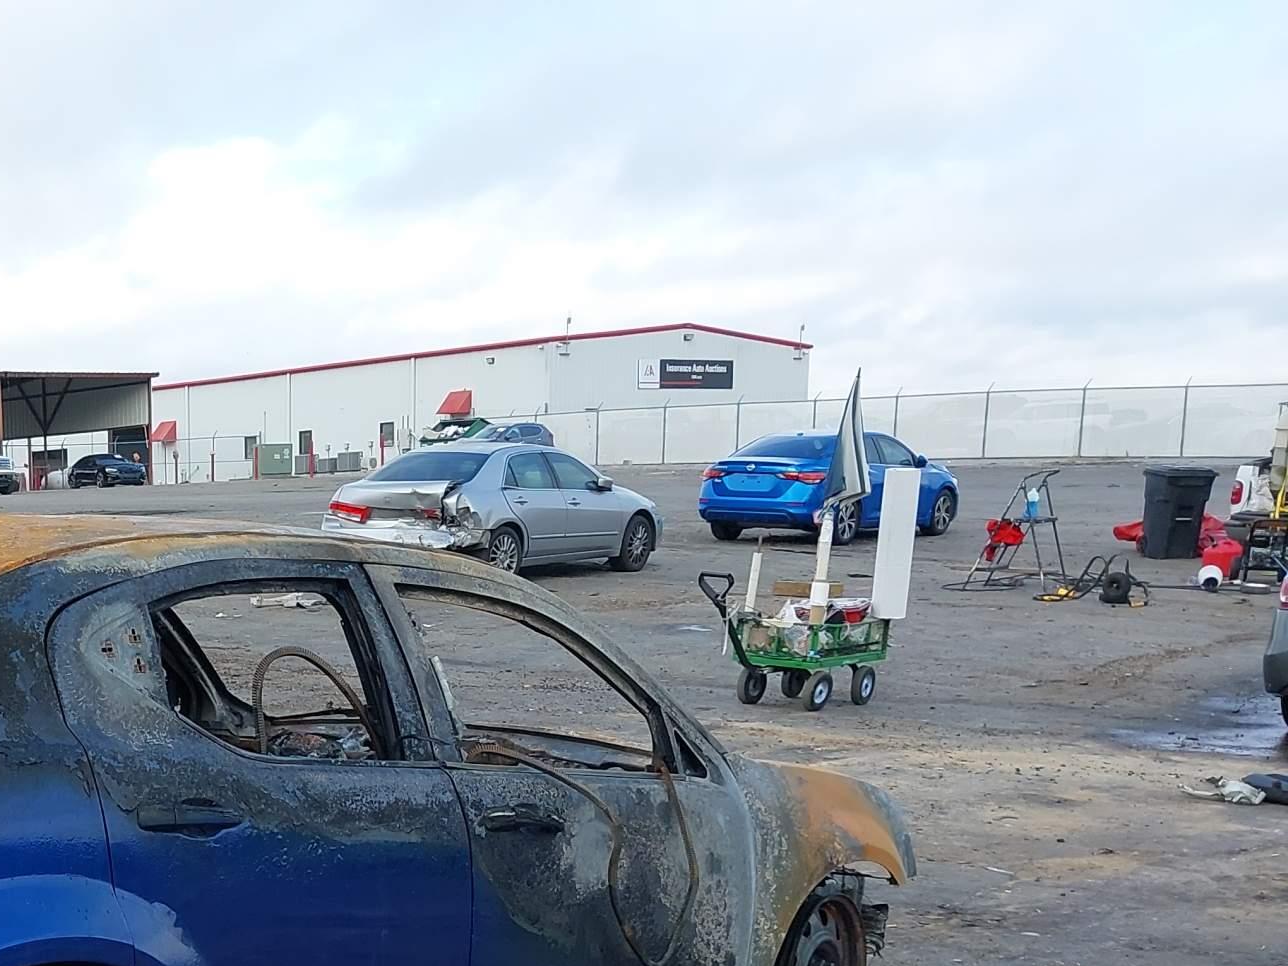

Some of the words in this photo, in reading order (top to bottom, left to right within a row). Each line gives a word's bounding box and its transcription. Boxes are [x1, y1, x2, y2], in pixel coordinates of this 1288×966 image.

[666, 363, 692, 372] Insurance
[692, 363, 705, 373] Auto
[705, 363, 727, 373] Auctions
